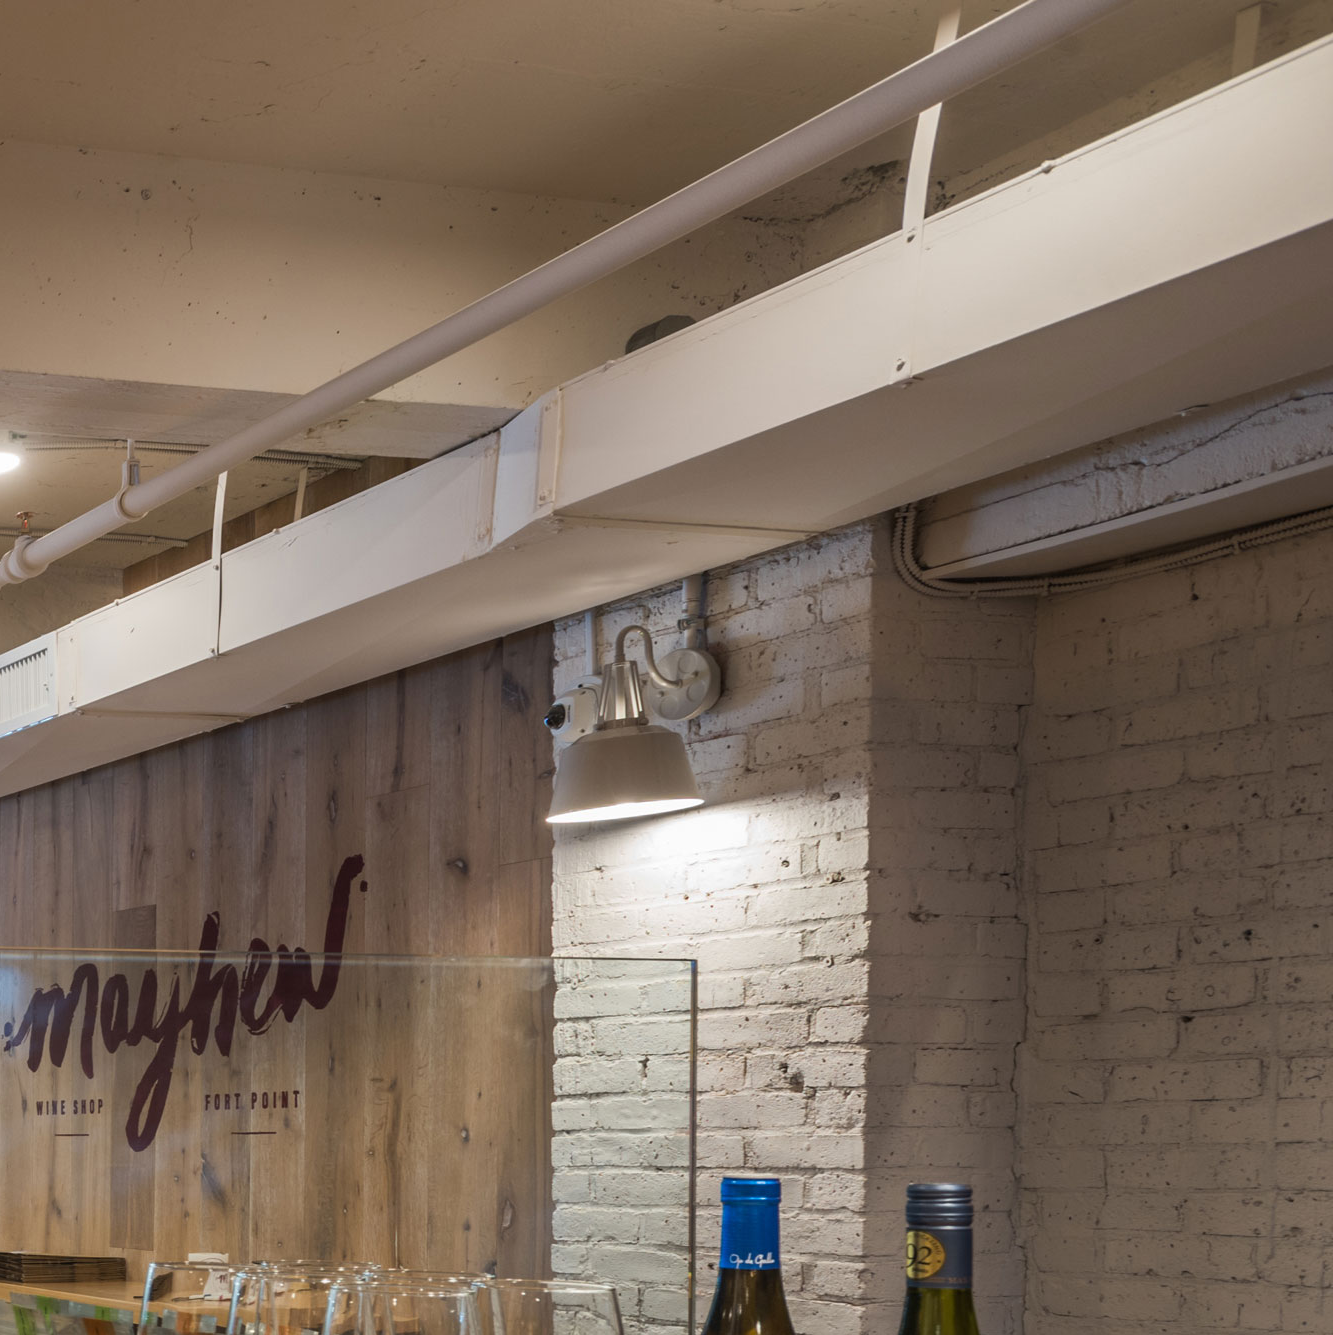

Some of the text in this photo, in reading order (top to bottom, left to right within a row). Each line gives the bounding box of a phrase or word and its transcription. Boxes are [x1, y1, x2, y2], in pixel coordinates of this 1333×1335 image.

[4, 854, 364, 1152] mayhew
[36, 1098, 104, 1116] WINE SHOP
[205, 1090, 301, 1111] FORT POINT
[906, 1243, 932, 1268] 92
